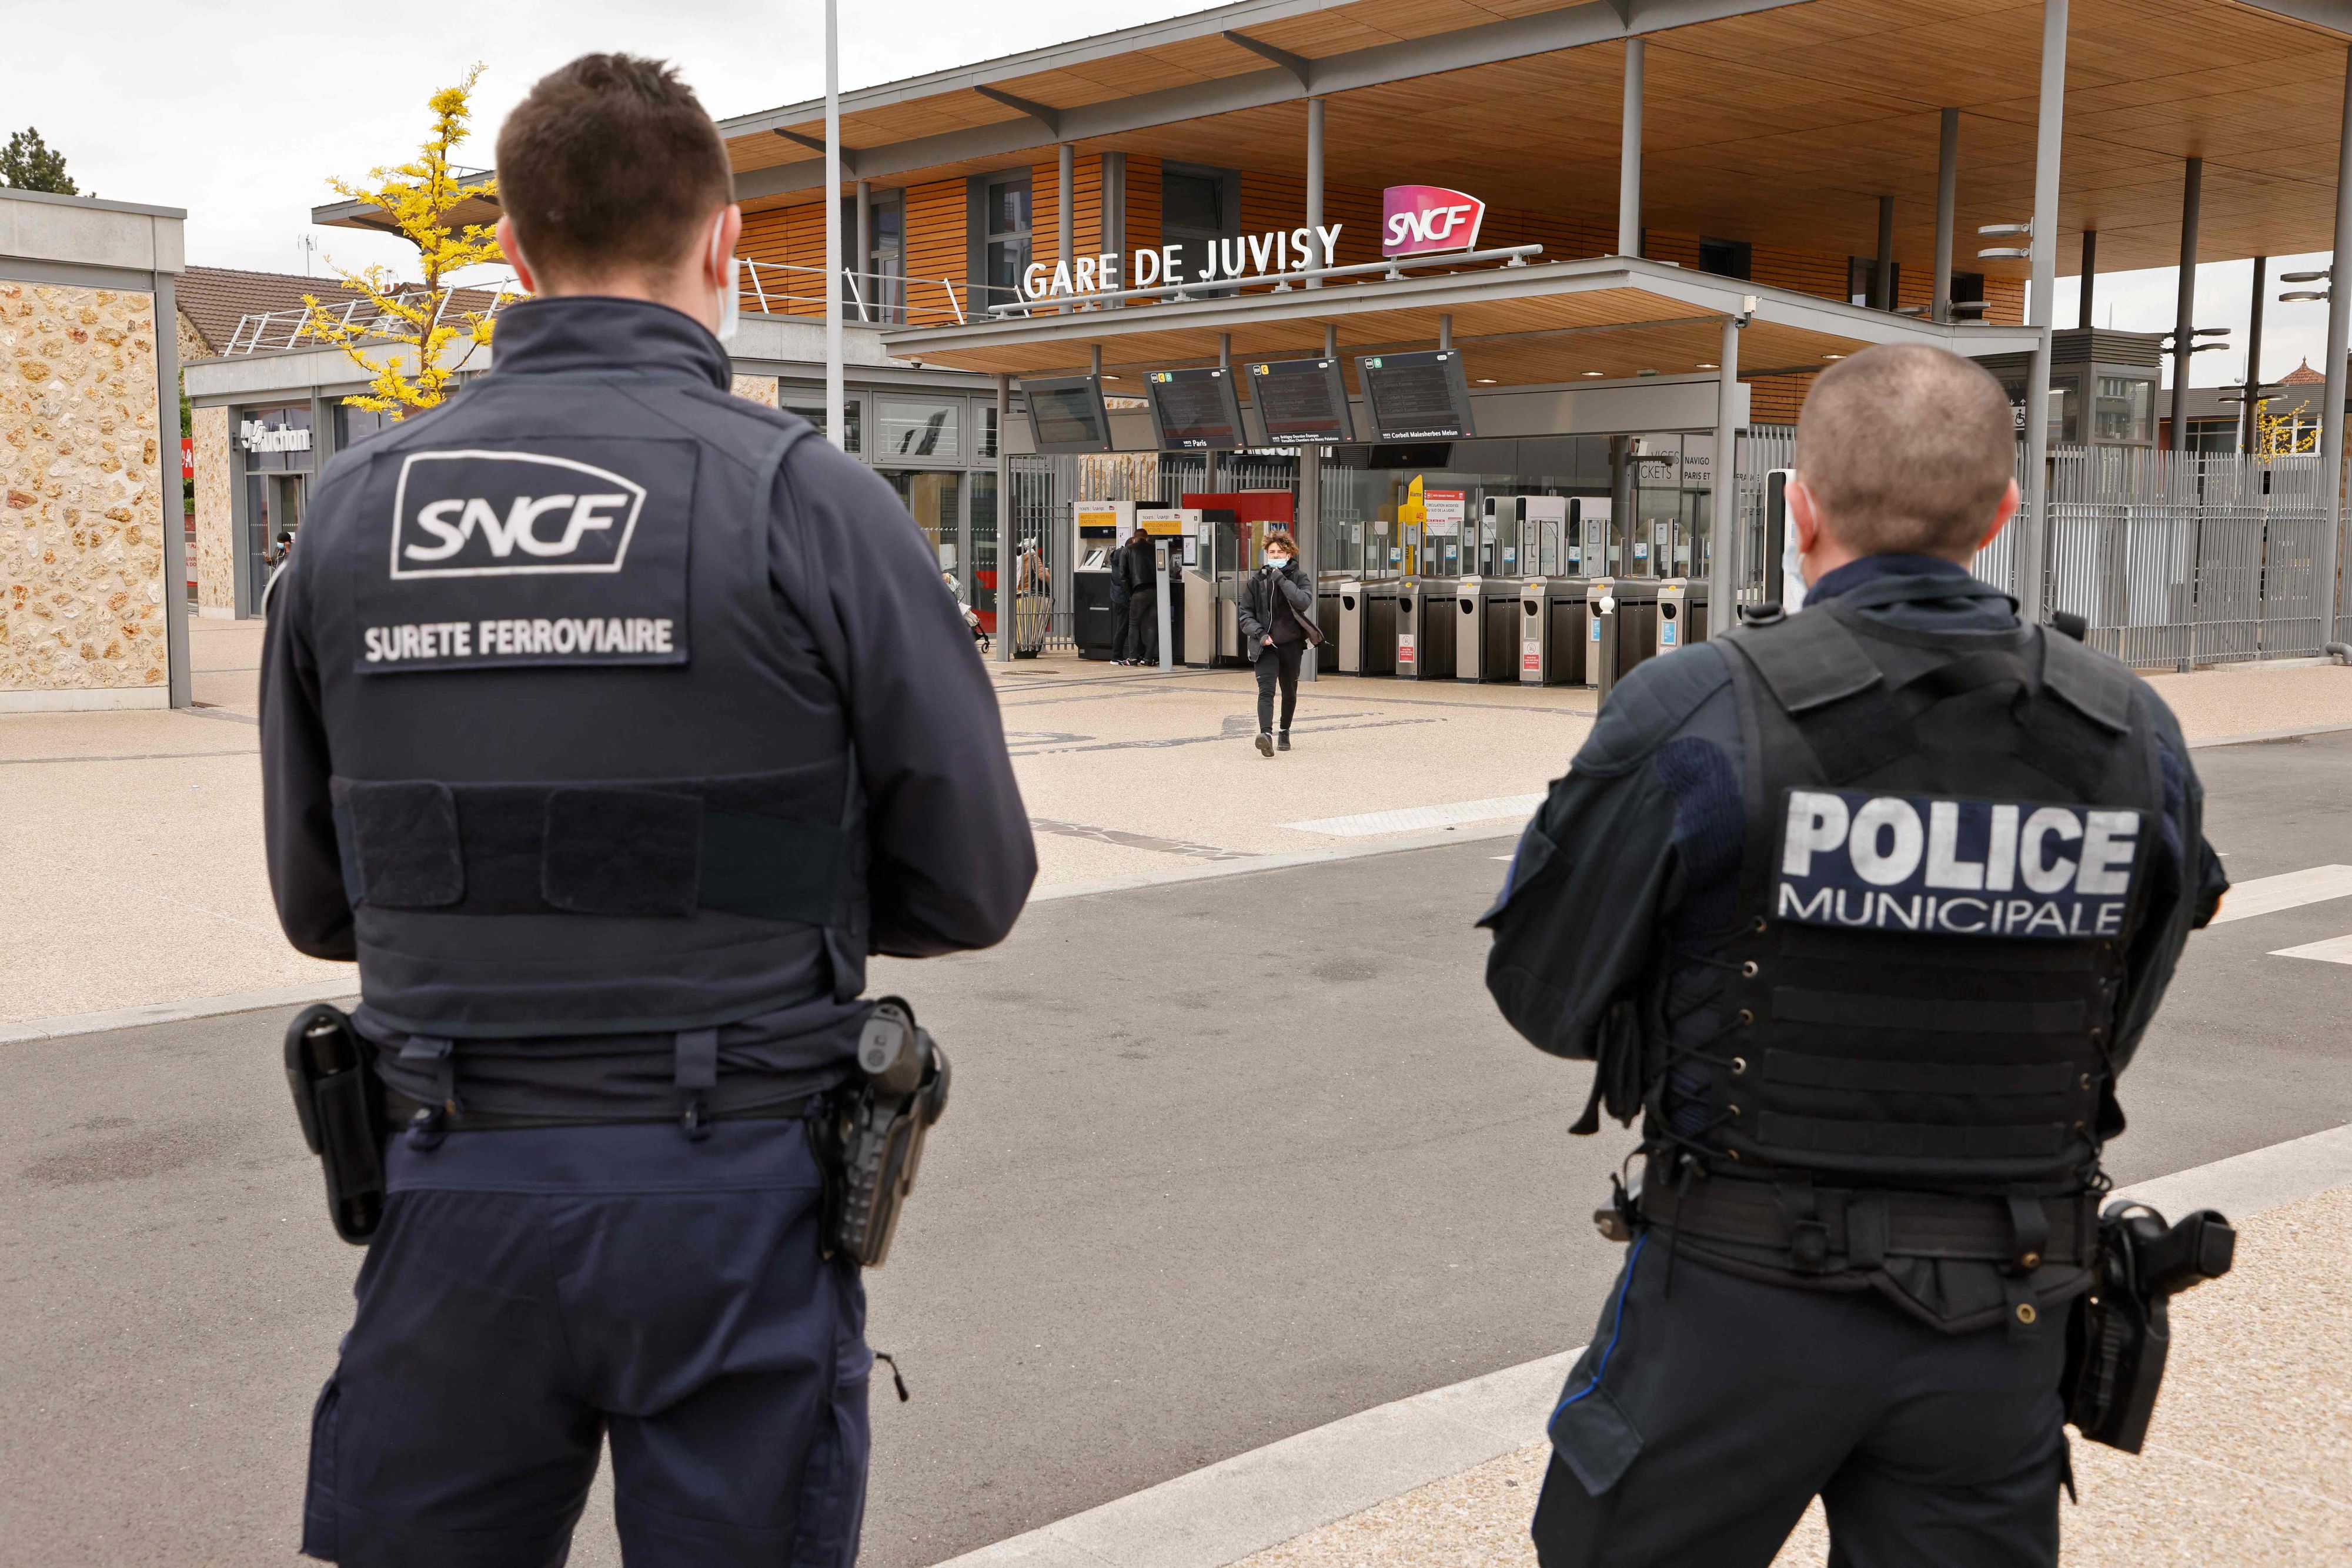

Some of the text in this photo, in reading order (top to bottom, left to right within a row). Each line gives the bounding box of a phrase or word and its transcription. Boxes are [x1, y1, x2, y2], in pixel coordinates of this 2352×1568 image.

[1384, 204, 1472, 248] SNCF
[1023, 223, 1344, 299] GARE DE JUVISY
[251, 420, 310, 453] Auchan
[1684, 472, 1702, 480] PARIS
[1685, 457, 1709, 465] NAVIGO
[403, 493, 629, 561] SNCF
[364, 617, 674, 663] SURETE FERROVIAIRE
[1781, 790, 2140, 895] POLICE
[1778, 882, 2125, 936] MUNICIPALE
